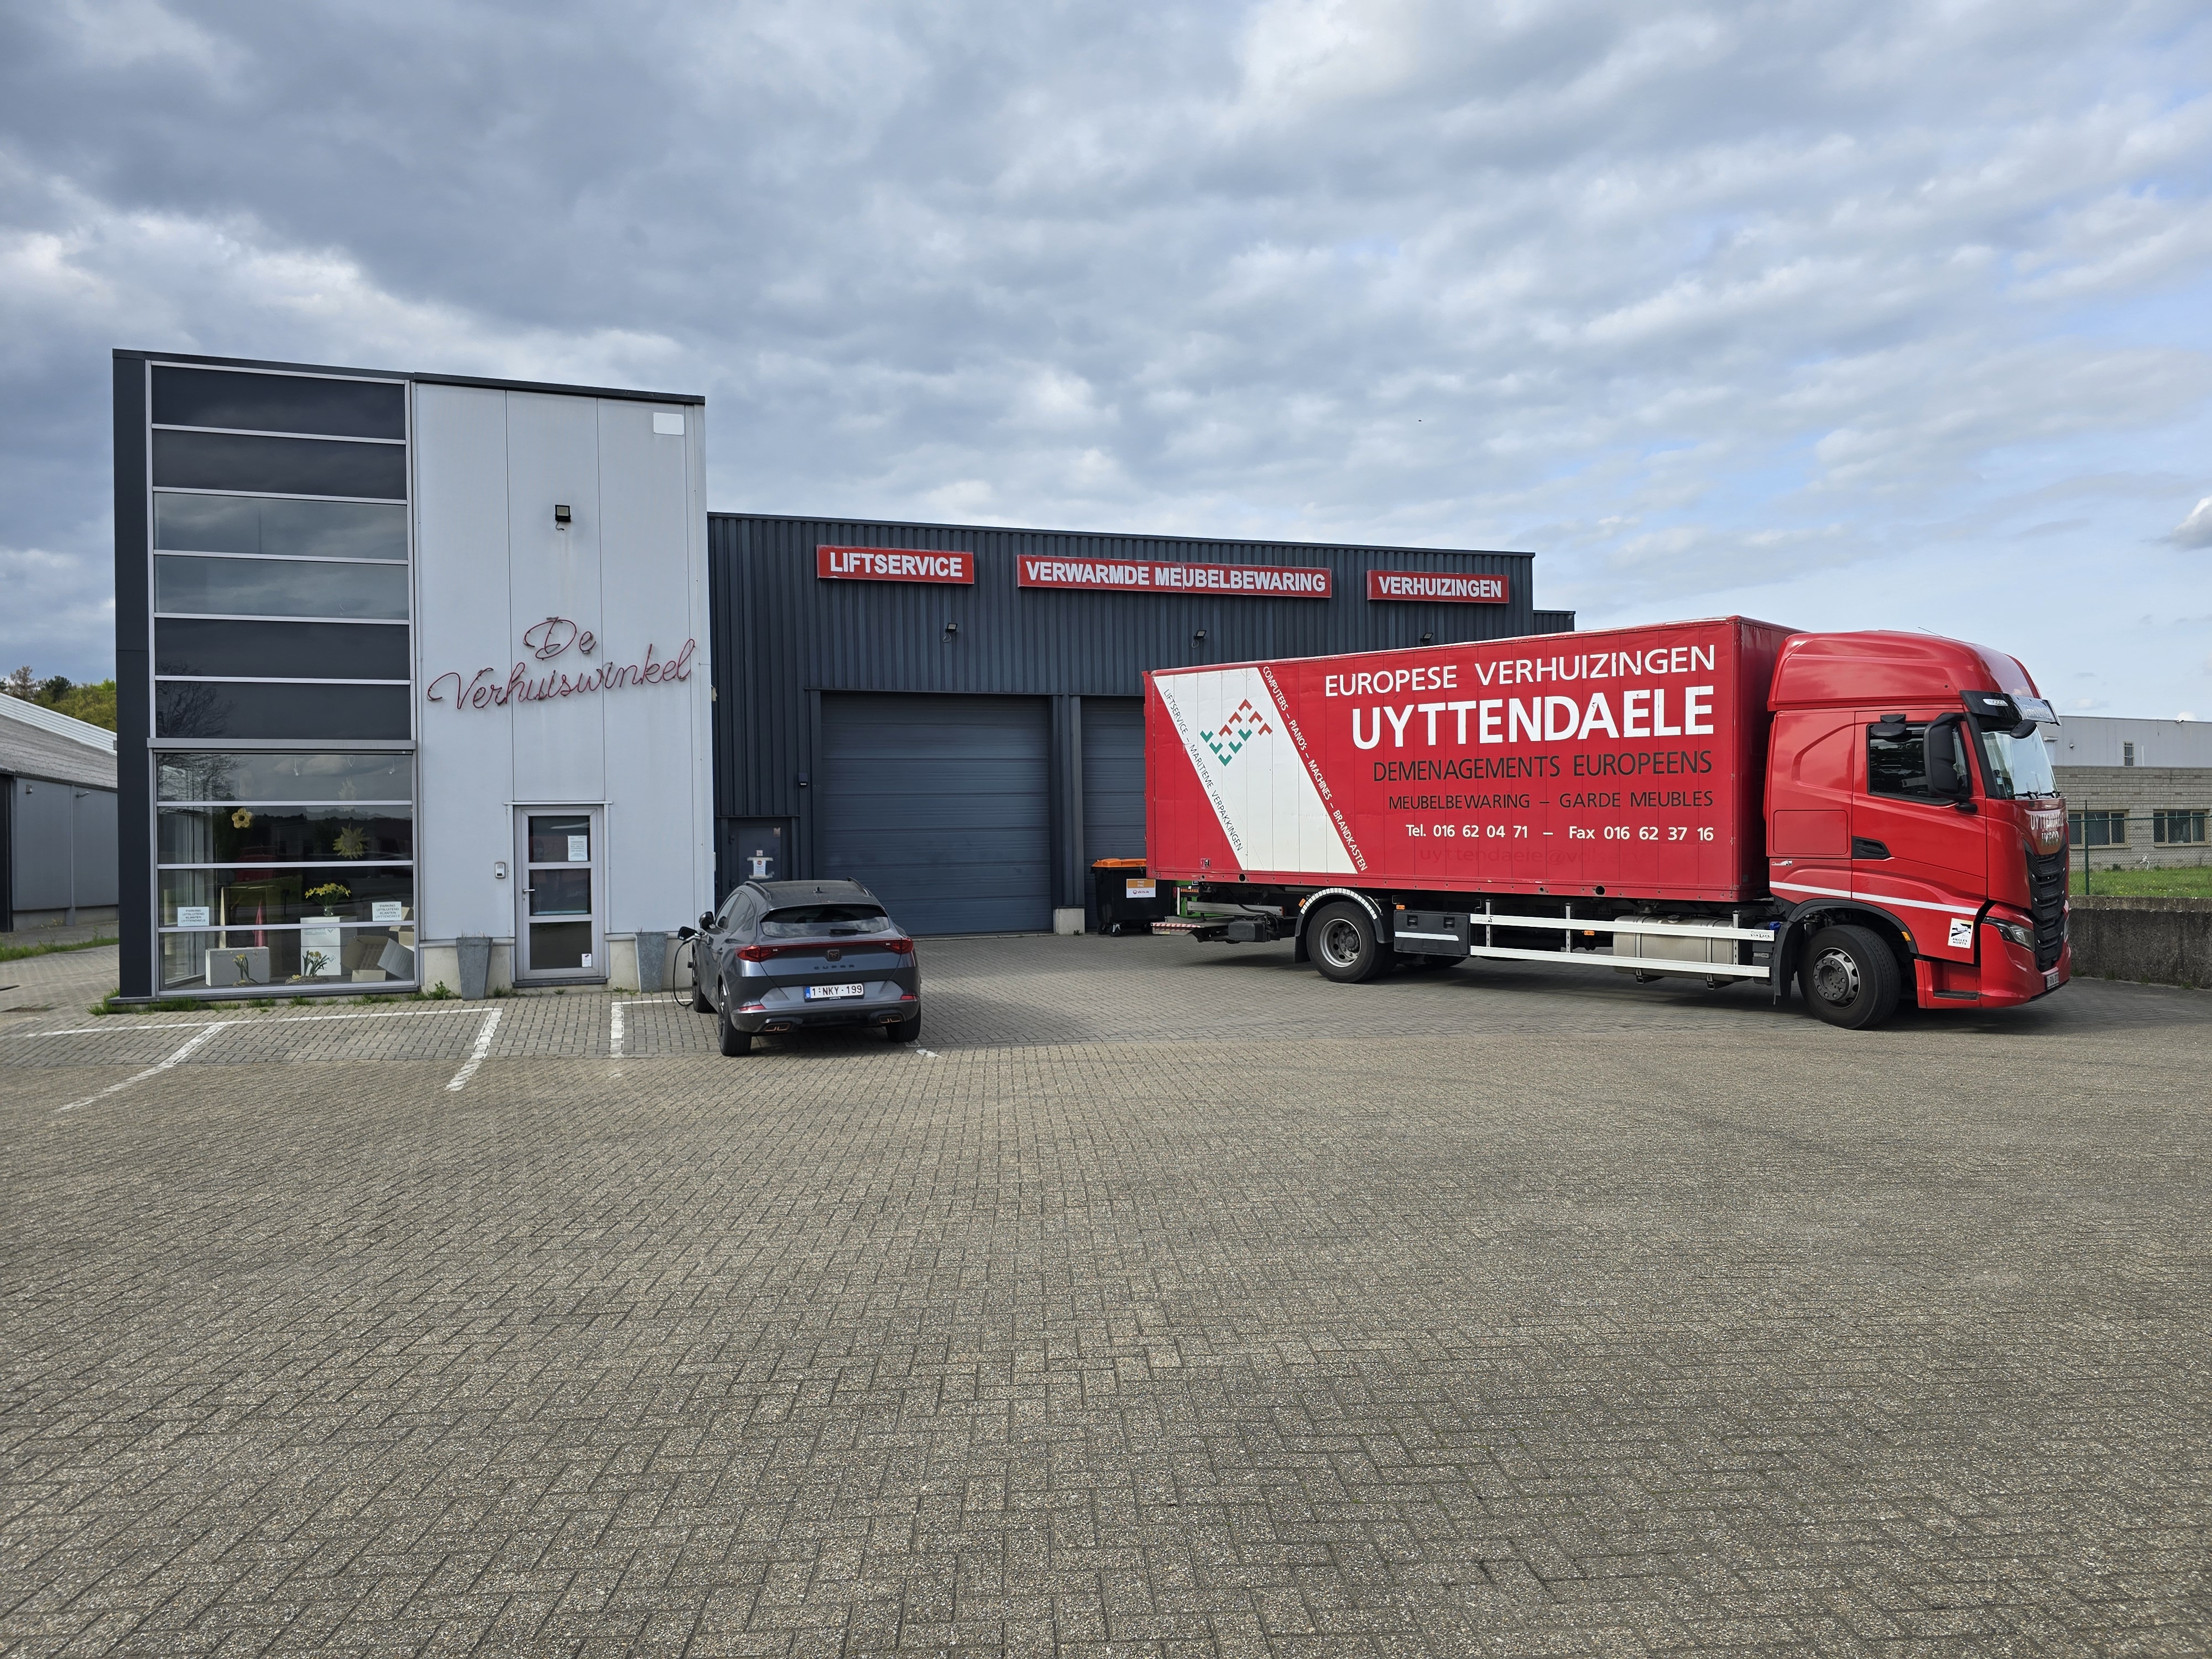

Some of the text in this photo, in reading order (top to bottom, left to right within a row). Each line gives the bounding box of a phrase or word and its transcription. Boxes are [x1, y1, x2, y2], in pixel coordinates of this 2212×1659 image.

[830, 552, 963, 577] LIFTSERVICE
[1025, 561, 1326, 592] VERWARMDE MEUBELBEWARING
[1378, 576, 1501, 598] VERHUIZINGEN
[523, 617, 597, 661] De
[427, 639, 696, 709] Verhuiswinkel
[1326, 644, 1714, 697] EUROPESE VERHUIZINGEN
[1352, 685, 1714, 750] UYTTENDAELE
[1164, 688, 1188, 735] LIFTSERVICE
[1190, 744, 1214, 789] MARITIEME
[1212, 790, 1243, 851] VERPAKKINGEN
[1262, 666, 1289, 711] COMPUTERS
[1308, 759, 1332, 800] MACHINES
[1333, 809, 1368, 871] BRANDKASTEN
[1374, 750, 1713, 782] DEMENAGEMENTS EUROPEENS
[1389, 794, 1530, 810] MEUBELBEWARING
[1559, 792, 1621, 808] GARDE
[1630, 790, 1713, 807] MEUBLES
[1405, 823, 1426, 837] Tel.
[1433, 825, 1455, 837] 016
[1462, 825, 1479, 838] 62
[1486, 825, 1506, 838] 04
[1513, 825, 1527, 838] 71
[1569, 826, 1595, 839] Fax
[1604, 826, 1630, 840] 016
[1639, 826, 1659, 841] 62
[1668, 827, 1688, 841] 37
[1697, 827, 1714, 841] 16
